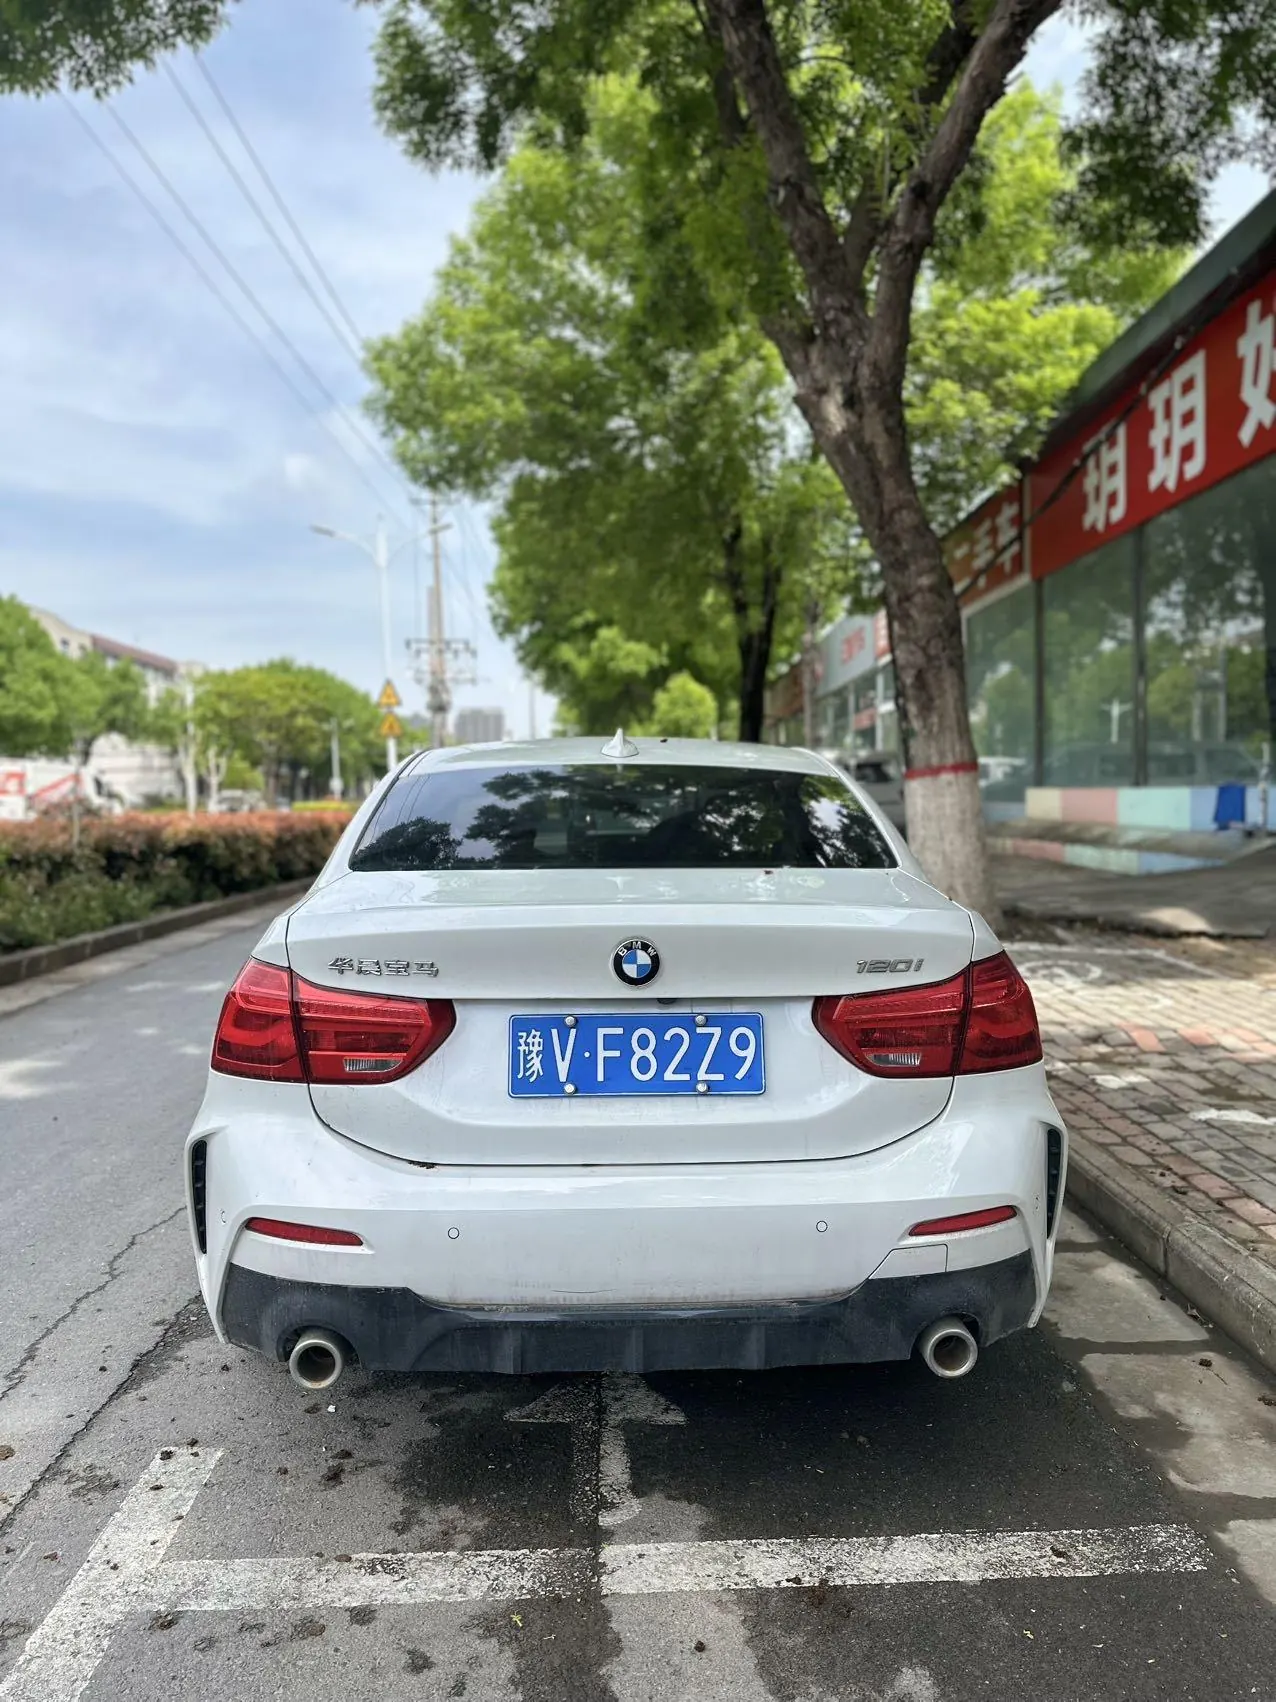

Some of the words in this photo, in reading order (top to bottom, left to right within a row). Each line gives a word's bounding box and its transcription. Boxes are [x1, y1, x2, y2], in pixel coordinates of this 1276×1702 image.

[618, 941, 656, 956] BMW
[327, 957, 439, 977] 华晨宝马
[857, 959, 924, 973] 120i
